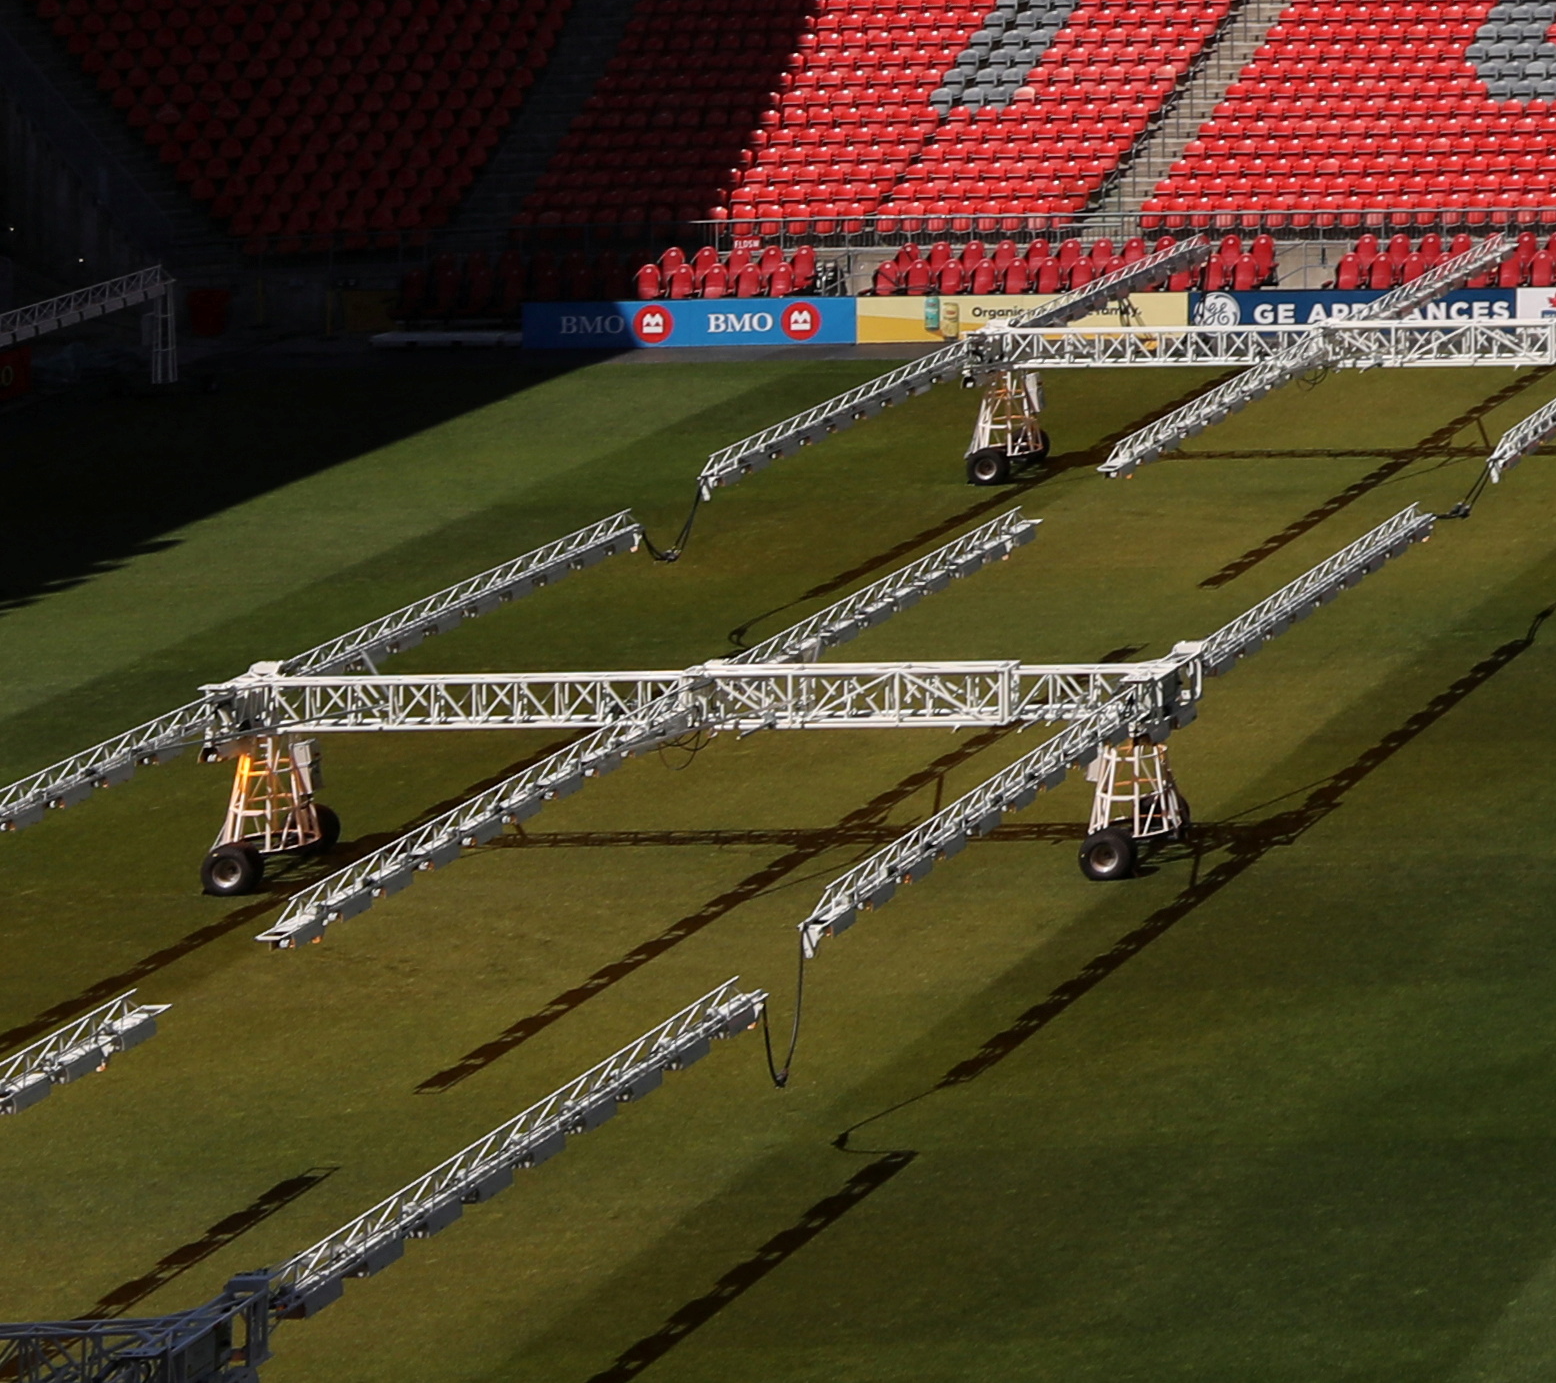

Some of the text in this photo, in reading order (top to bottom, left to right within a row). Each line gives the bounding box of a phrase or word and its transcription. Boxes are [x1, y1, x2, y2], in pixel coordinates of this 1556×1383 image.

[559, 314, 625, 335] BMO
[708, 312, 773, 334] BMO
[1253, 303, 1296, 325] GE
